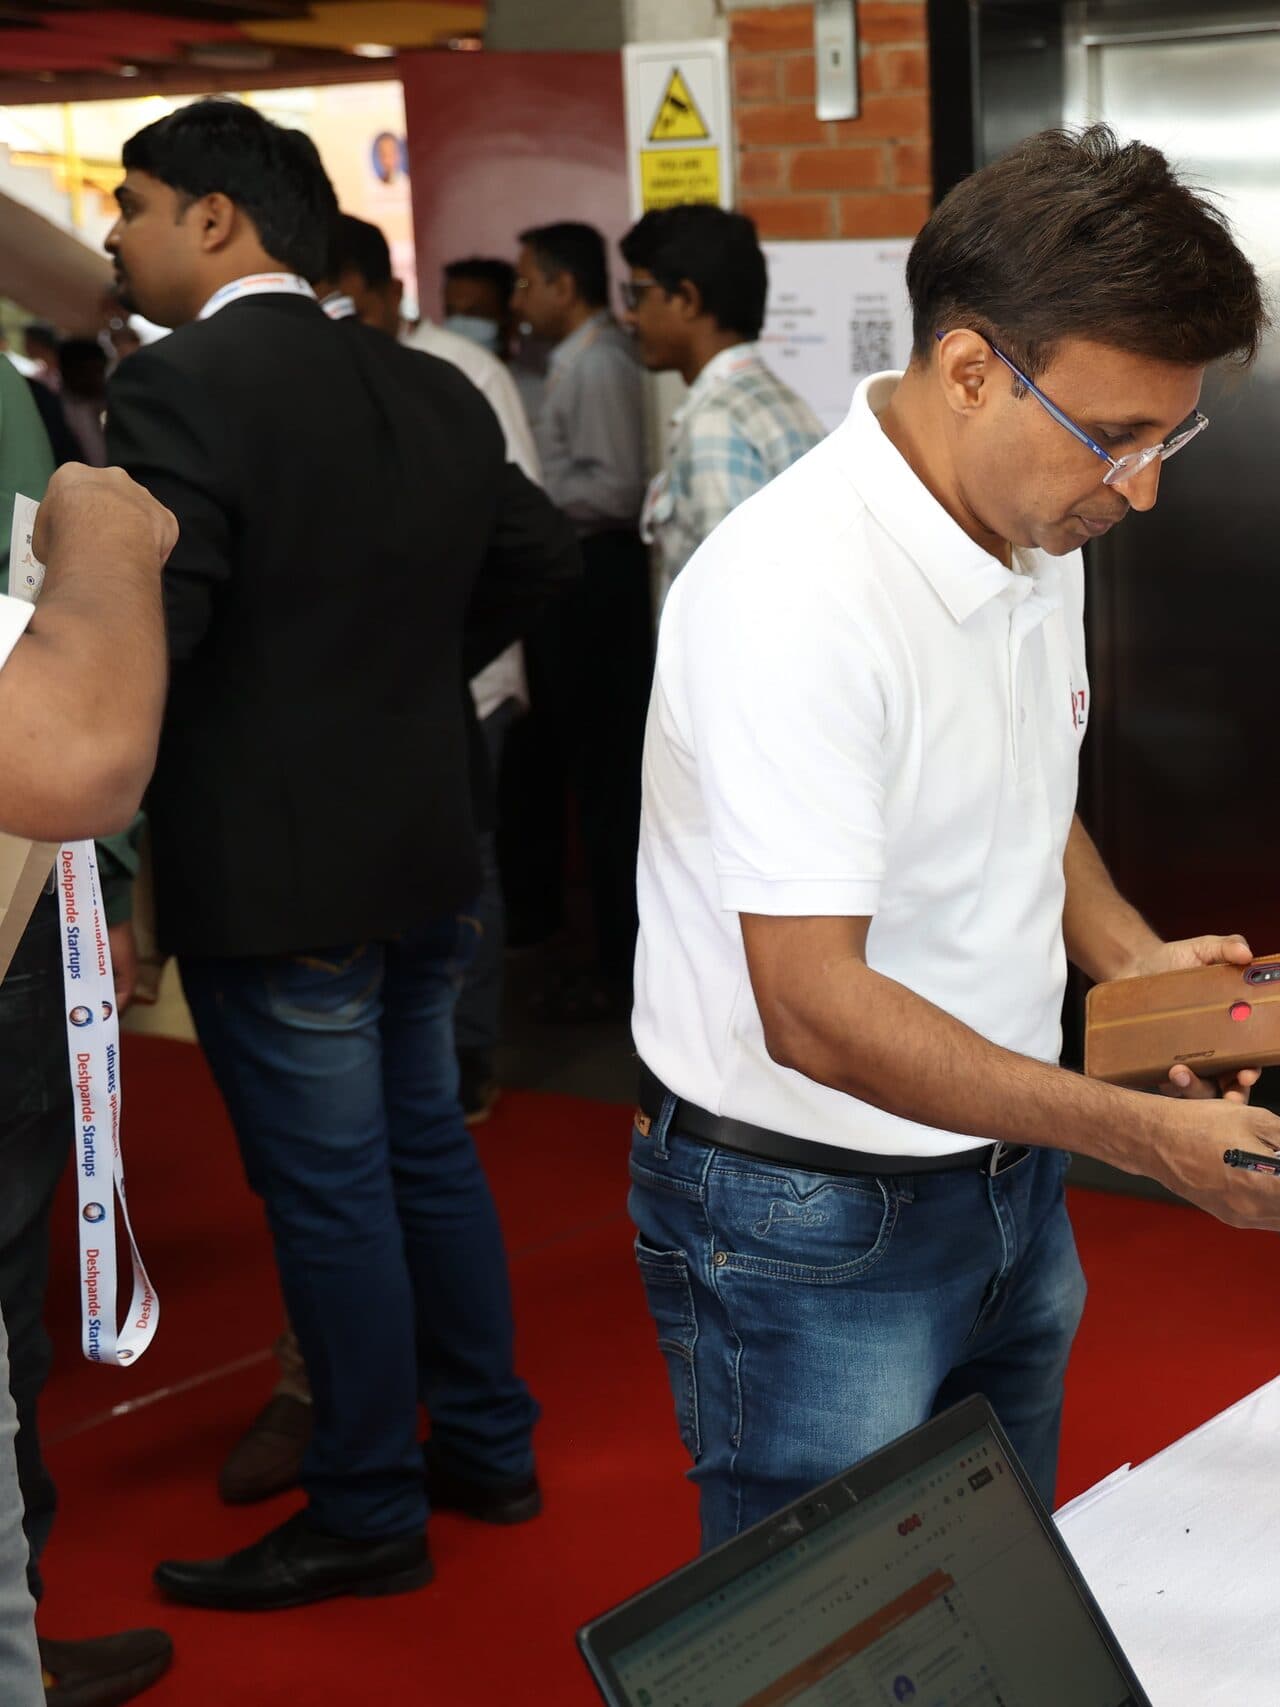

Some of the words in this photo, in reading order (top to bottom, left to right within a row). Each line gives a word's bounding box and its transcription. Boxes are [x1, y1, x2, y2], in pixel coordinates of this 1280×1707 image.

[61, 850, 80, 924] Deshpande
[66, 926, 81, 980] Startups
[76, 1053, 96, 1122] Deshpande
[82, 1125, 96, 1177] Startups
[84, 1248, 102, 1317] Deshpande
[88, 1319, 103, 1360] Startup
